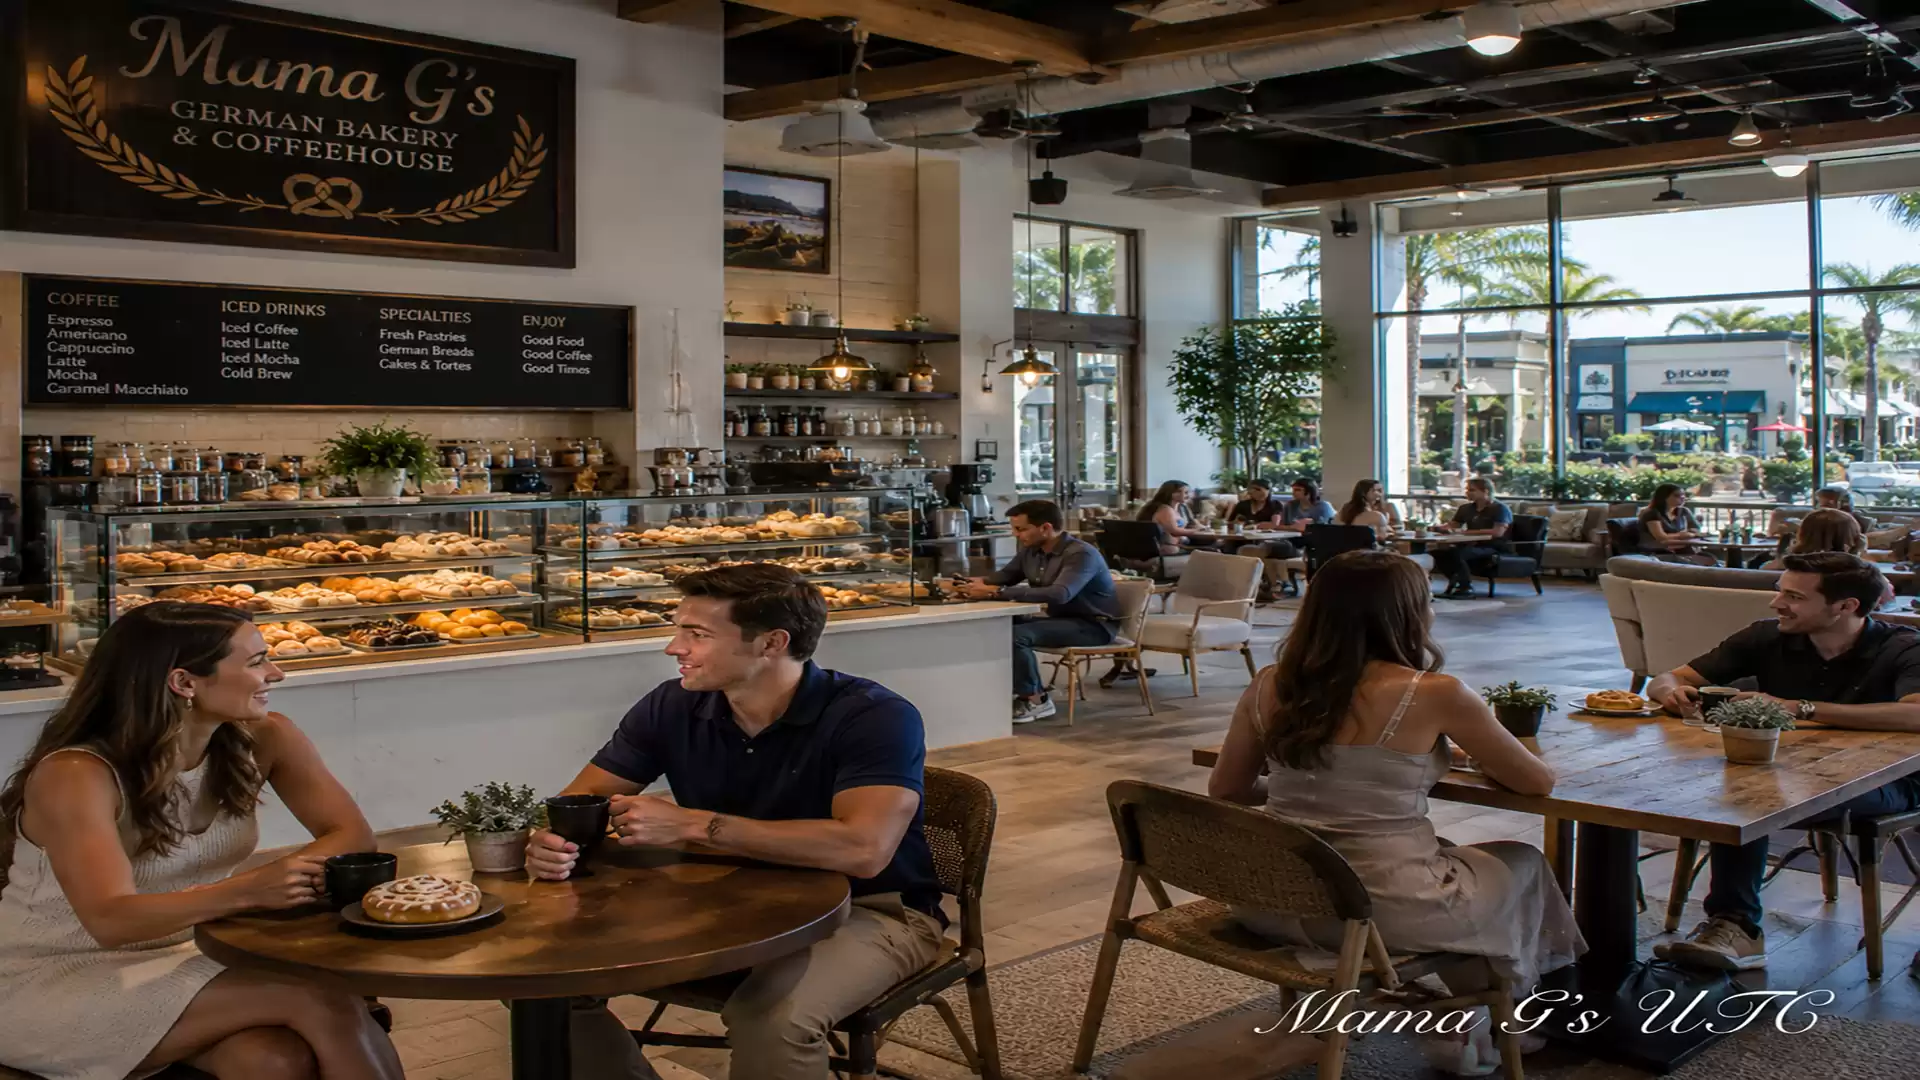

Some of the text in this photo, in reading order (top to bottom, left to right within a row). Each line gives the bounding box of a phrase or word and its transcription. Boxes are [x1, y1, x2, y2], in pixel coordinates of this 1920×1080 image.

[119, 15, 495, 125] Mama G's
[171, 100, 459, 150] GERMAN BAKERY
[173, 127, 454, 173] & COFFEEHOUSE
[47, 292, 119, 307] COFFEE
[221, 300, 325, 317] ICED DRINKS
[379, 307, 471, 324] SPECIALTIES
[47, 313, 113, 328] Espresso
[522, 314, 566, 329] ENJOY
[46, 326, 127, 341] Americano
[221, 321, 298, 336] Iced Coffee
[379, 328, 466, 343] Fresh Pastries
[221, 336, 289, 350] Iced Latte
[522, 334, 584, 347] Good Food
[47, 341, 135, 355] Cappuccino
[378, 343, 474, 357] German Breads
[521, 348, 592, 361] Good Coffee
[47, 355, 87, 367] Latte
[221, 351, 299, 365] Iced Mocha
[378, 358, 471, 371] Cakes & Tortes
[47, 368, 97, 381] Mocha
[220, 366, 292, 380] Cold Brew
[522, 362, 590, 375] Good Times
[46, 382, 188, 396] Caramel Macchiato
